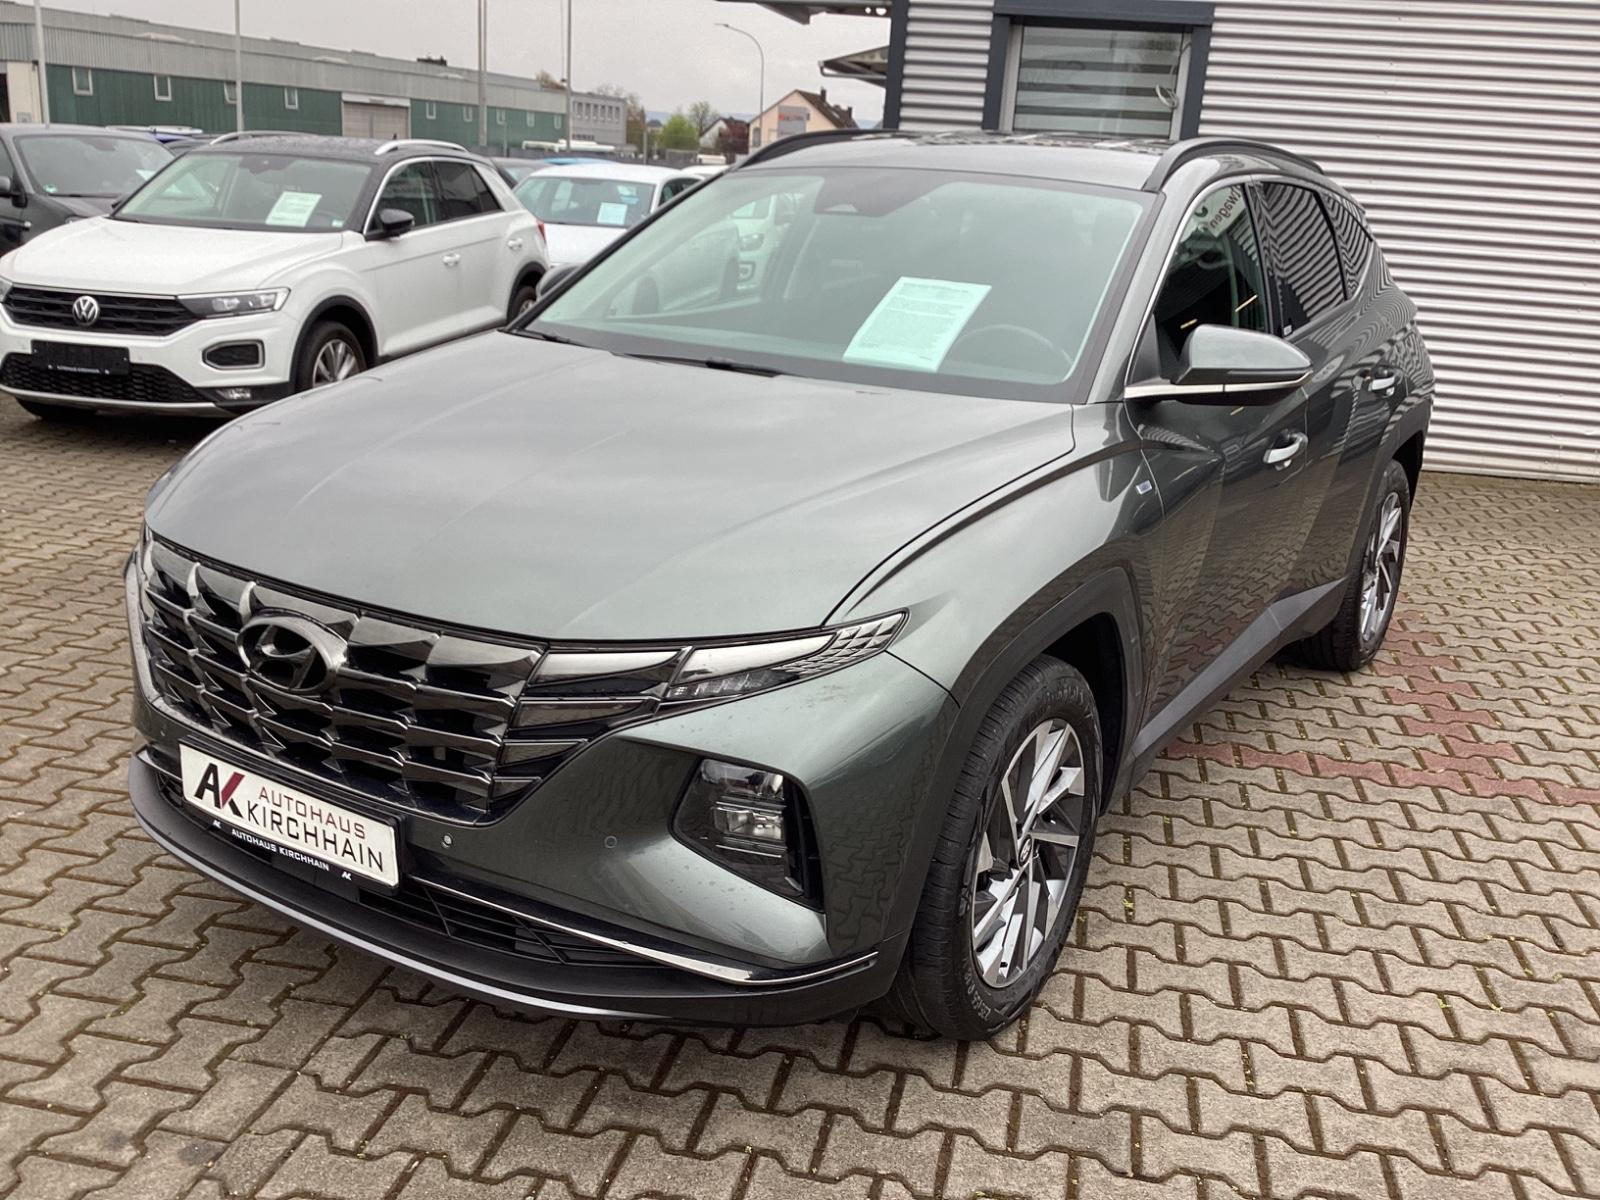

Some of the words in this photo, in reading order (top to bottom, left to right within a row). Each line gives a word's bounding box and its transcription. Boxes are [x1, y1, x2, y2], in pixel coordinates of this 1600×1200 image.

[73, 295, 99, 326] VW
[194, 762, 245, 818] AK
[258, 786, 365, 840] AUTOHAUS
[231, 828, 277, 852] AUTOHAUS
[278, 846, 330, 871] KIRCHHAIN
[247, 799, 384, 872] KIRCHHAIN
